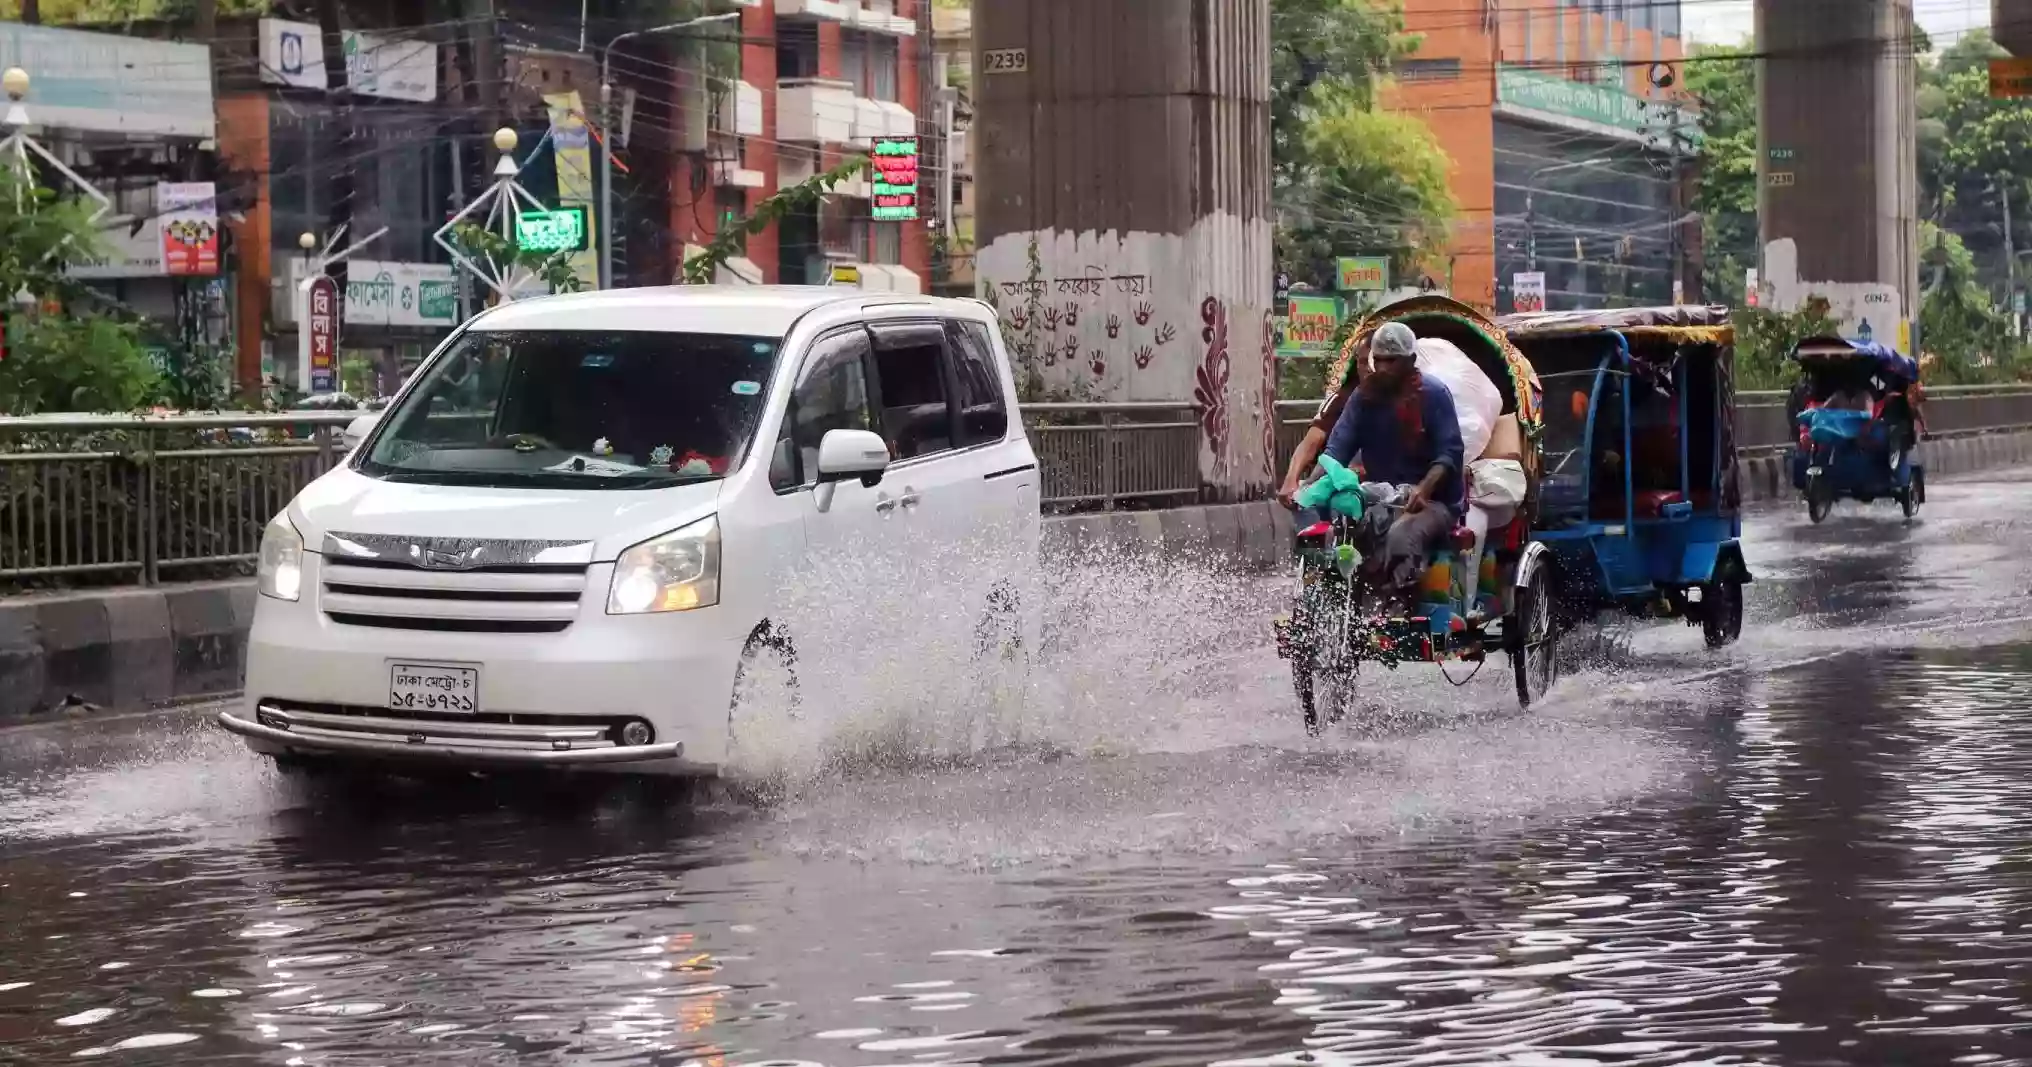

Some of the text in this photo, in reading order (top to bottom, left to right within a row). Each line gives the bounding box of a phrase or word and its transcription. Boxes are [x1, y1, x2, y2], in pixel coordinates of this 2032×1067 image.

[985, 52, 1025, 69] P239
[312, 288, 331, 354] বিলাস
[396, 675, 421, 686] ঢাকা
[392, 692, 473, 710] ১৫-৬৭২১
